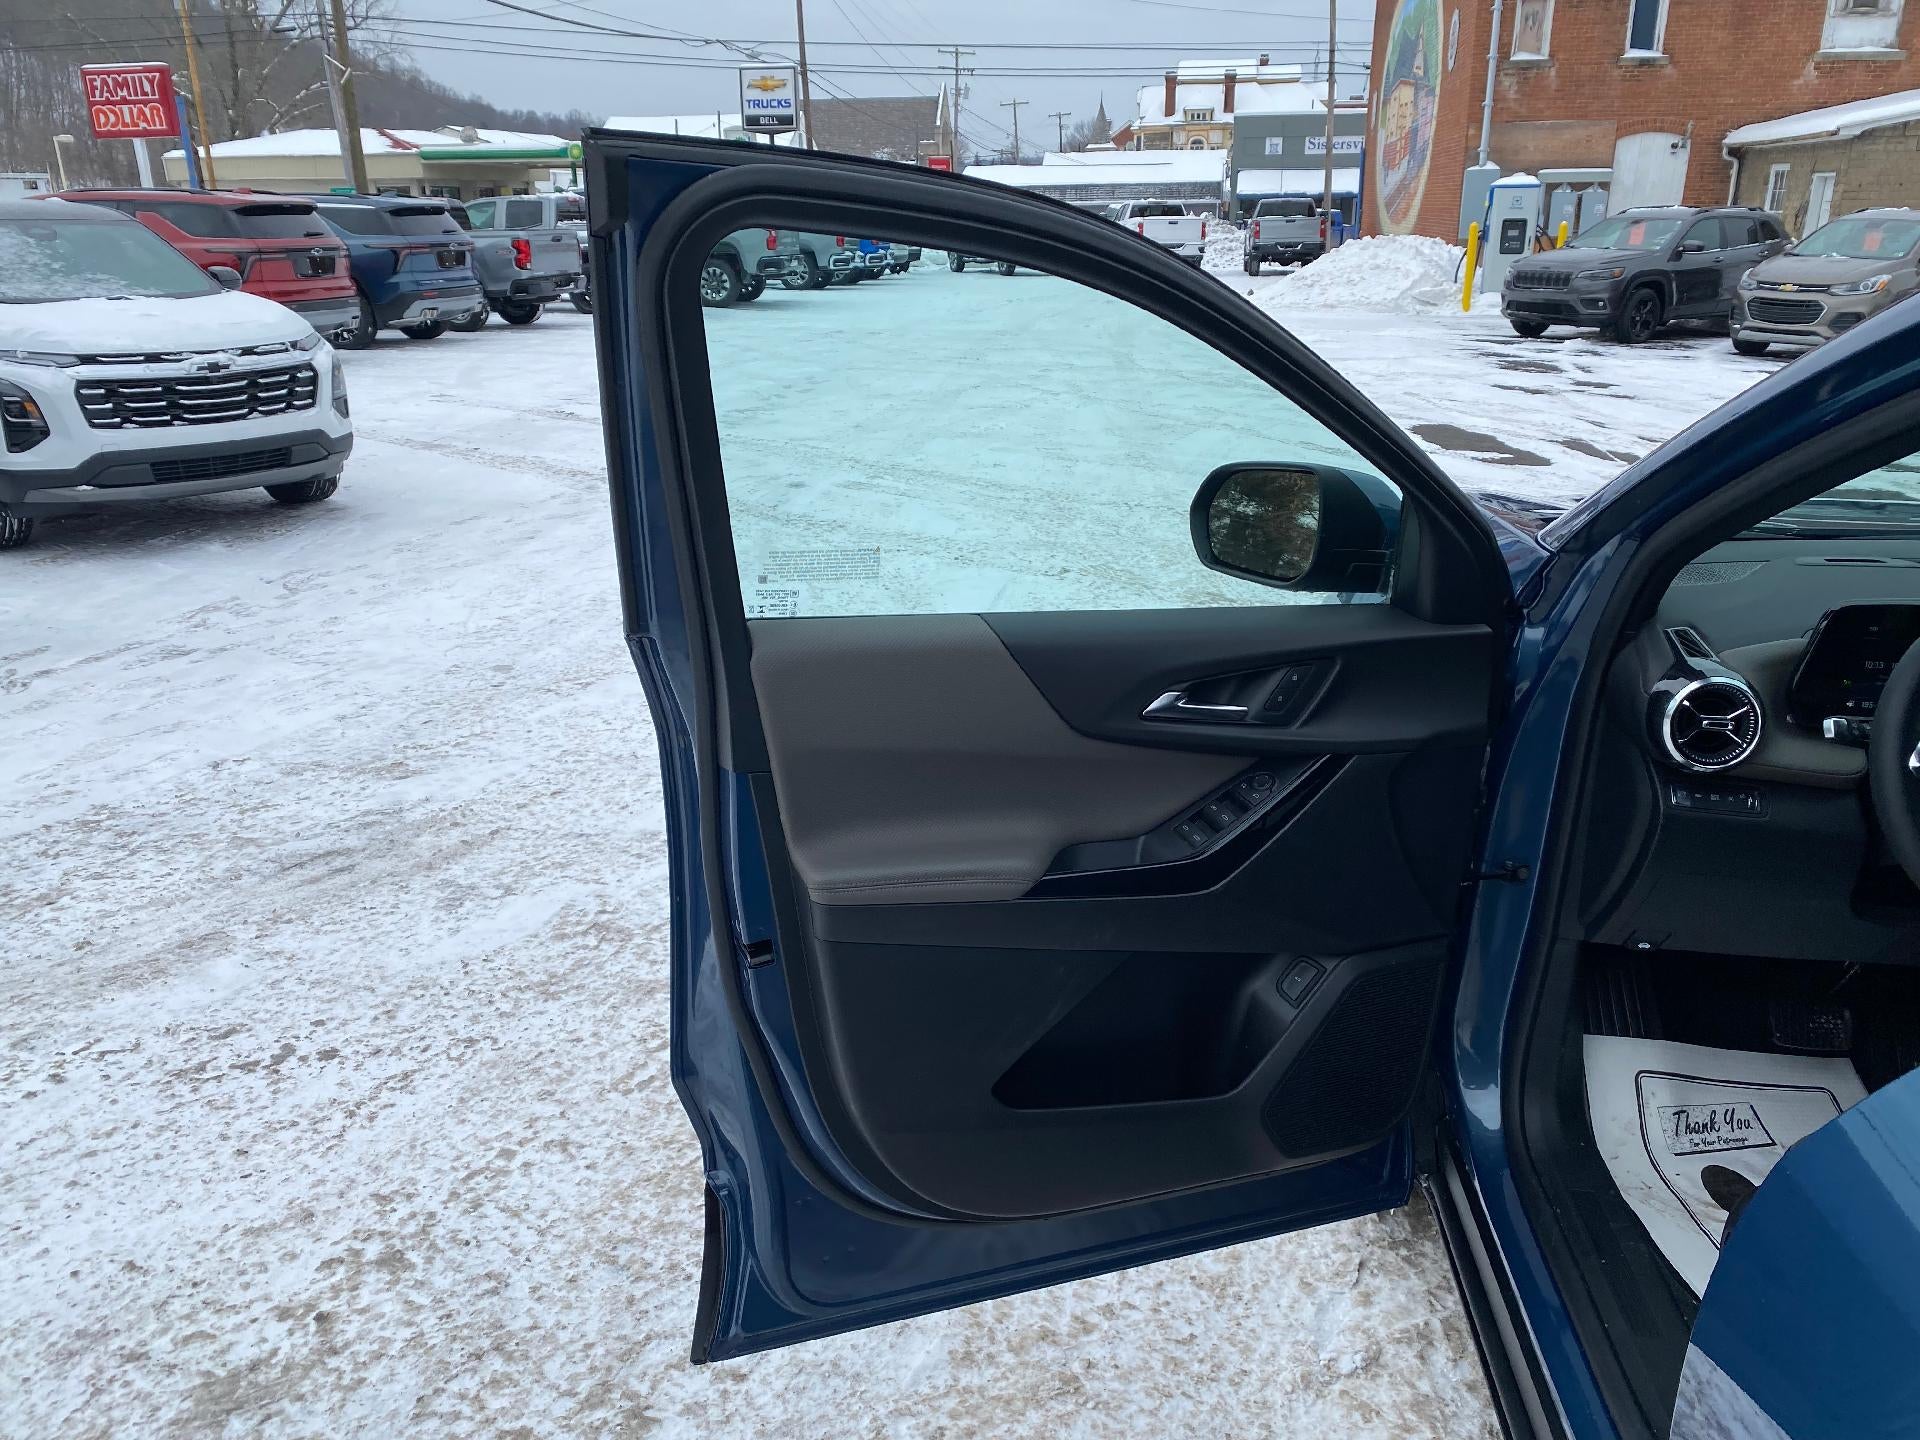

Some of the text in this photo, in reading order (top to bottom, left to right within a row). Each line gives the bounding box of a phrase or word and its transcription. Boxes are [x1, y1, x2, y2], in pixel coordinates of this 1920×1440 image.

[86, 73, 160, 100] FAMILY
[92, 103, 168, 130] DOLLAR
[745, 98, 792, 109] TRUCKS
[1672, 1107, 1754, 1137] Thank You
